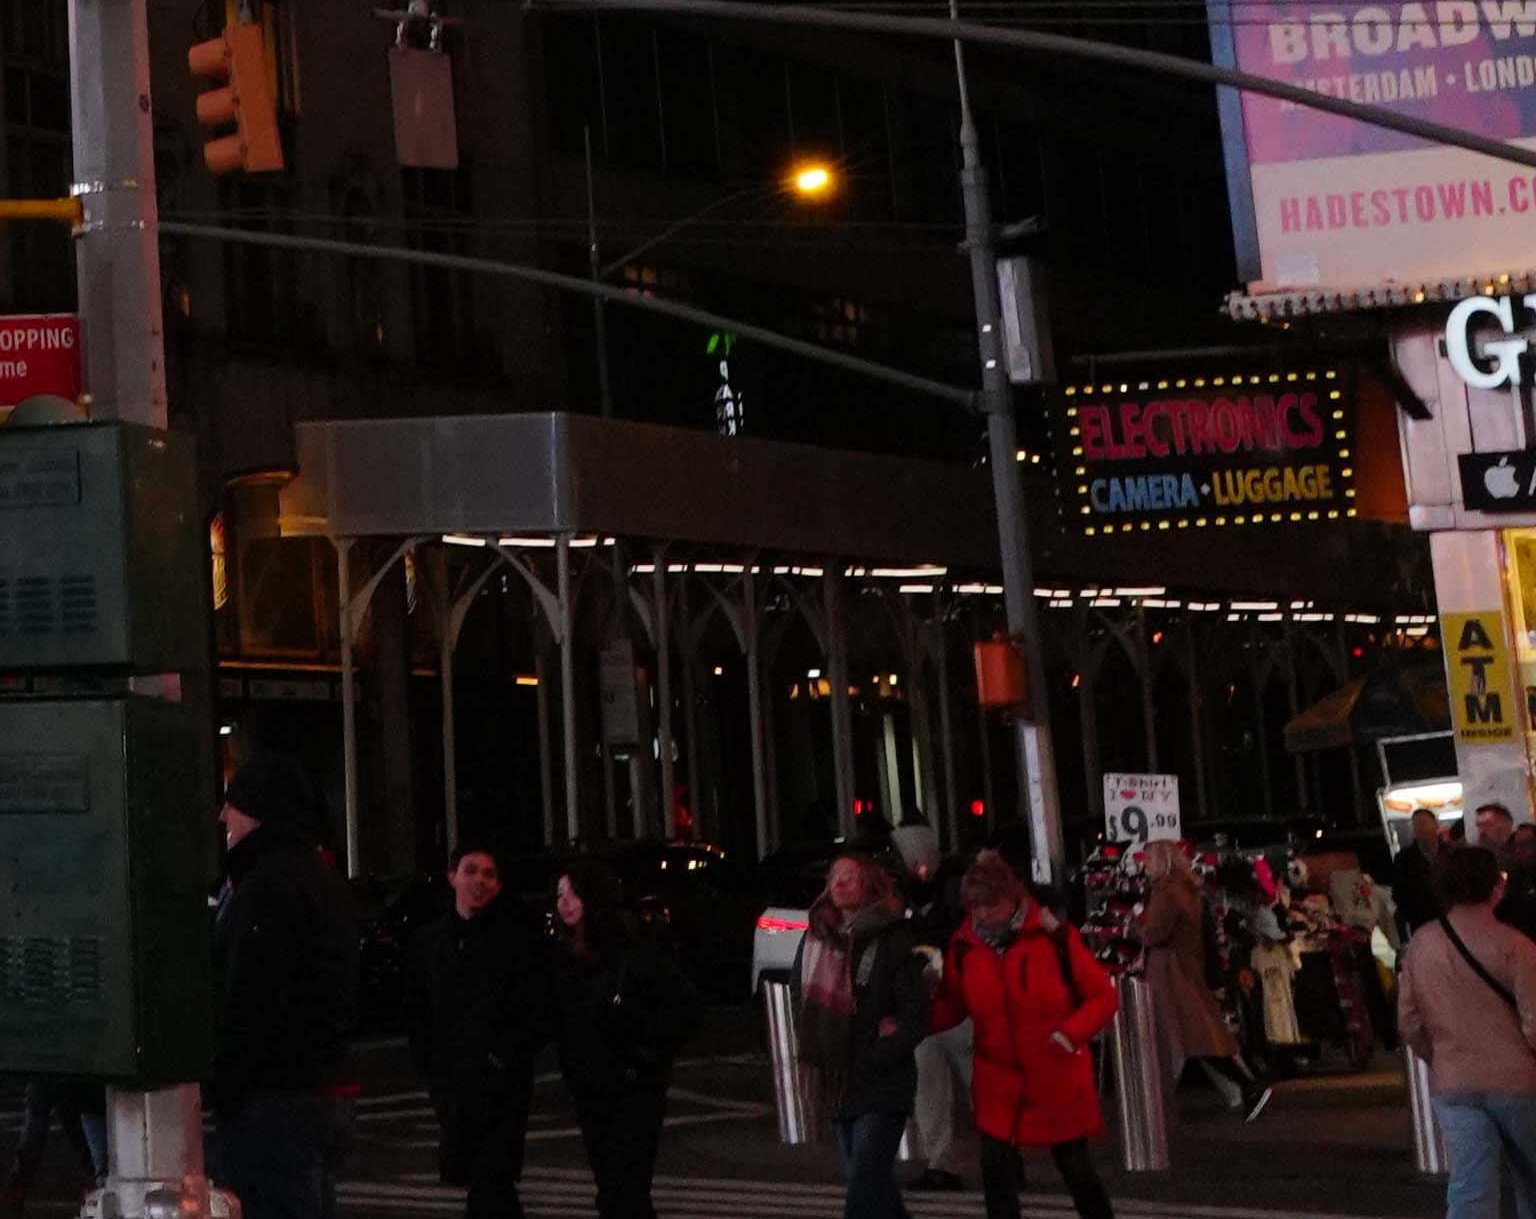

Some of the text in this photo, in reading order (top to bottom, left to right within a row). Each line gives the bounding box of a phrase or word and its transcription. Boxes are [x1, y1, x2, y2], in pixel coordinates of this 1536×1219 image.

[1446, 293, 1536, 389] G
[1078, 392, 1325, 461] ELECTRONICS
[1090, 464, 1334, 514] CAMERA LUGGAGE
[1457, 618, 1503, 723] ATM
